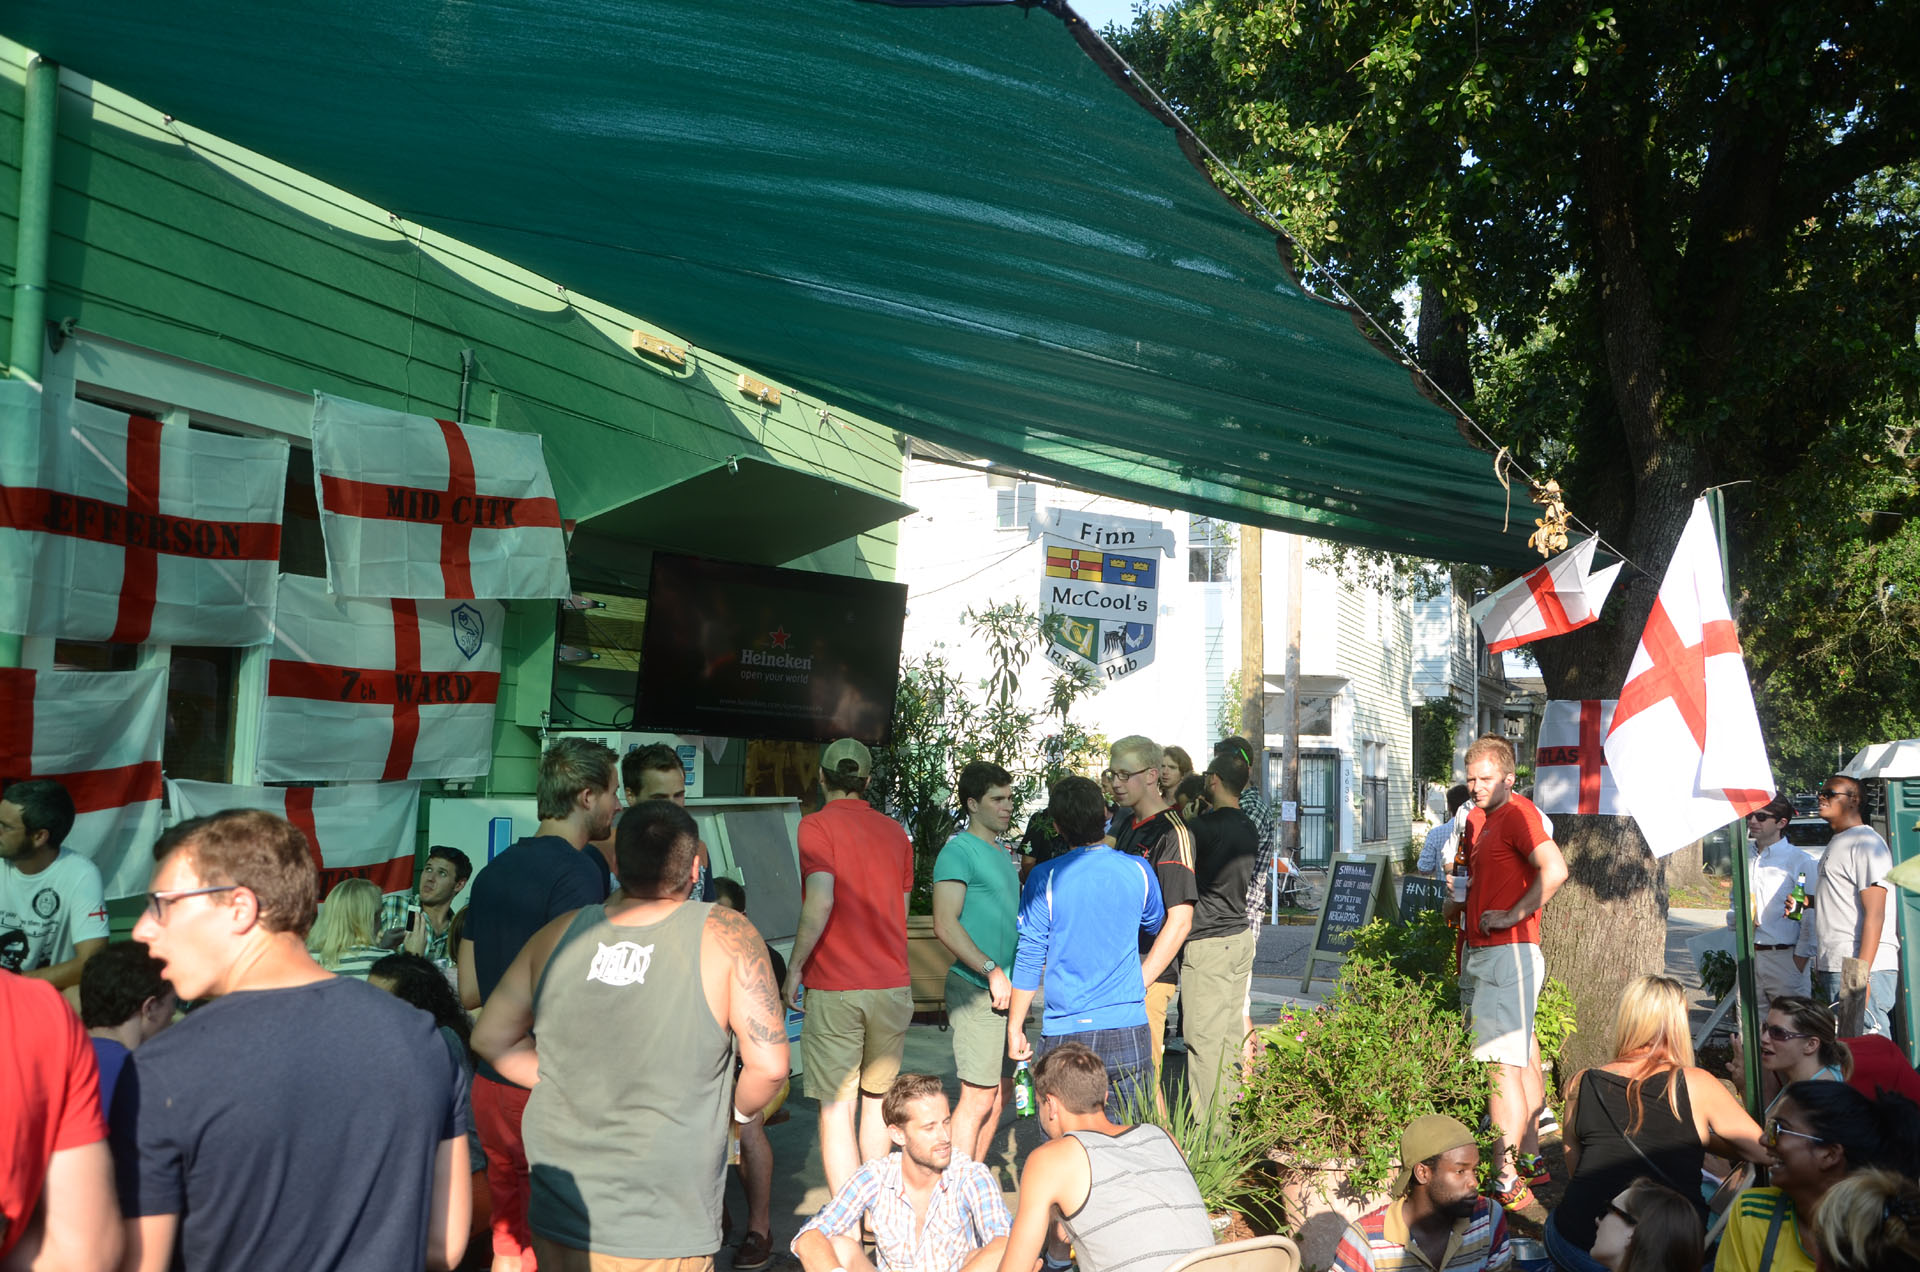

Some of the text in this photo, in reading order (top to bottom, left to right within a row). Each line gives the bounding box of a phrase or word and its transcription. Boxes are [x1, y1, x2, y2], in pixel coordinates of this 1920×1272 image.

[386, 488, 516, 526] MID CITY
[1080, 522, 1135, 545] Finn
[1052, 586, 1148, 612] McCool's
[740, 649, 812, 671] Heineken
[1106, 657, 1137, 680] Pub
[340, 670, 472, 704] 7th WARD
[740, 670, 809, 685] open your world
[1406, 882, 1443, 899] #NOL
[1328, 911, 1360, 923] NEIGHBORS
